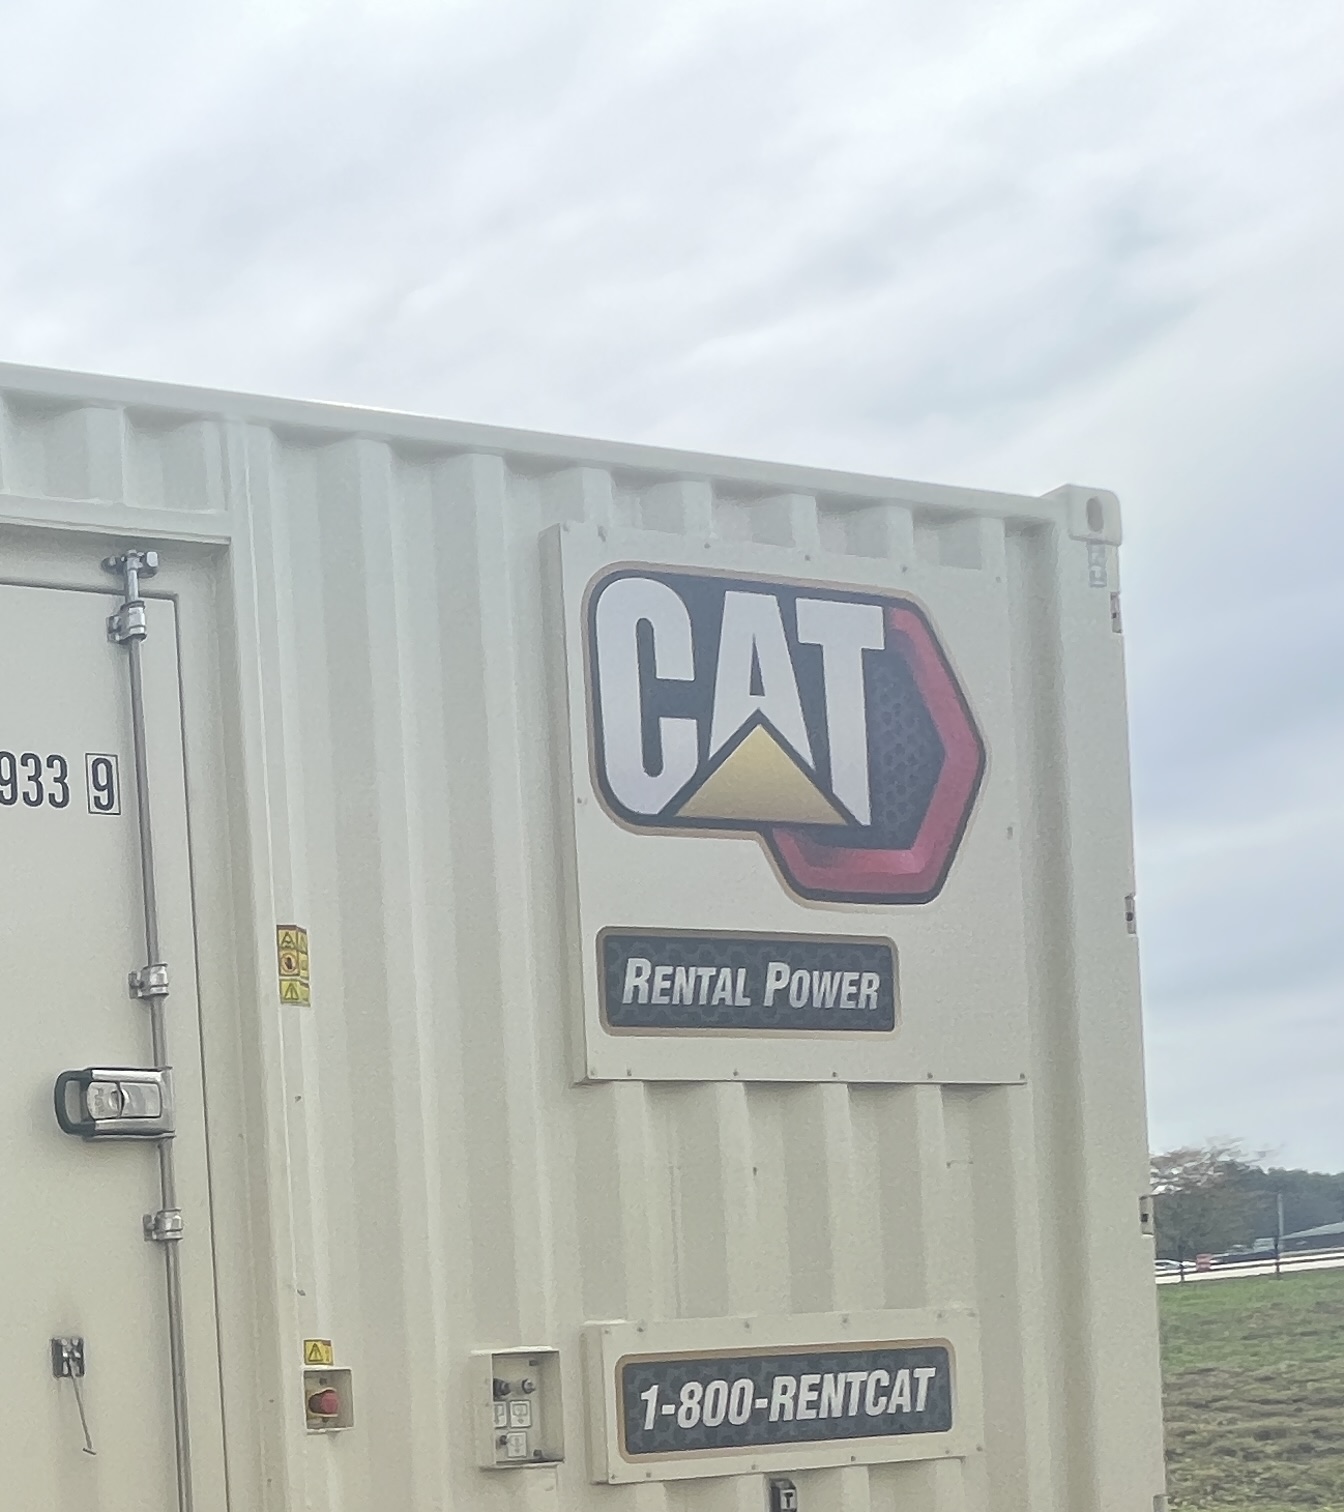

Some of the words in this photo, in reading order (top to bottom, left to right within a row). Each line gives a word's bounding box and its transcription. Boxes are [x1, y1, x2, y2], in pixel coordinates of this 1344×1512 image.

[595, 577, 886, 827] CAT
[90, 756, 115, 812] 9
[623, 958, 752, 1008] RENTAL
[764, 962, 881, 1012] POWER
[640, 1367, 936, 1431] 1-800-RENTCAT
